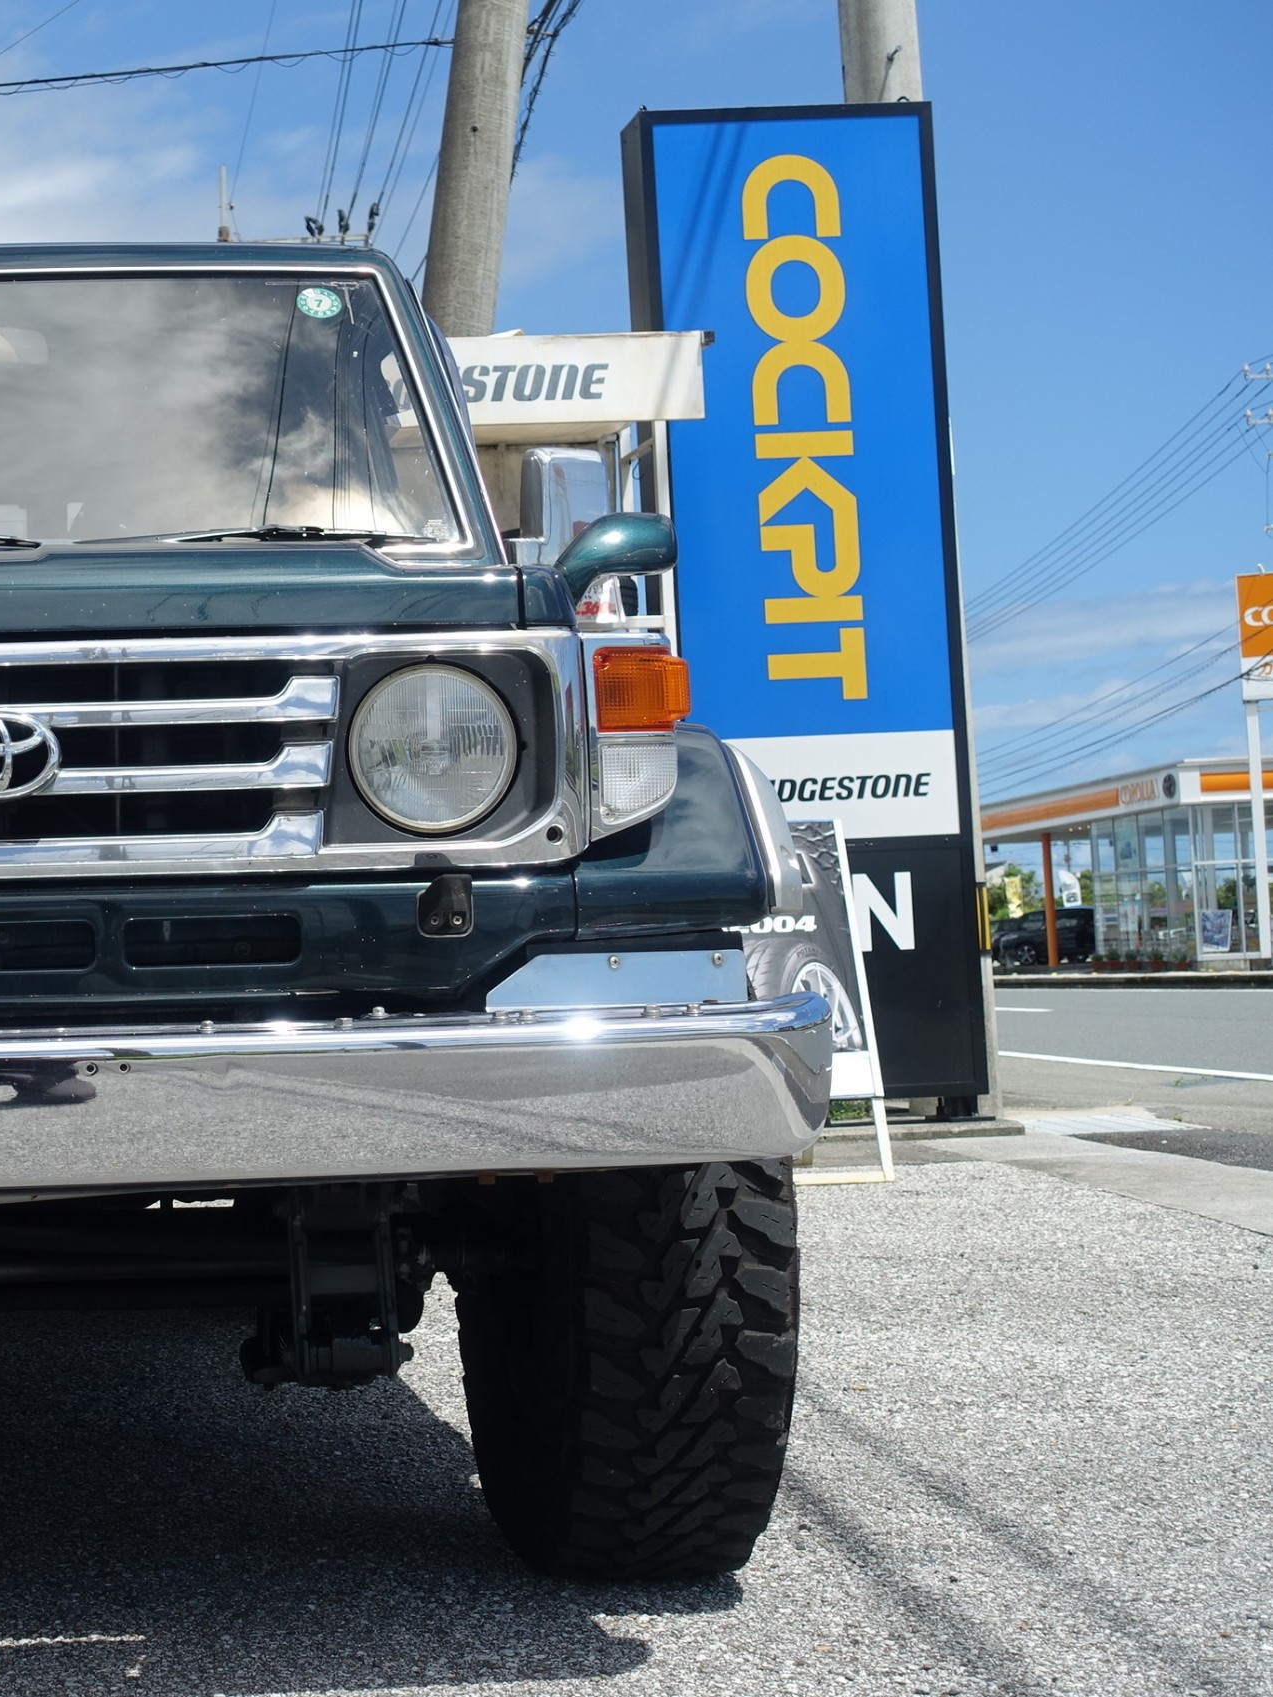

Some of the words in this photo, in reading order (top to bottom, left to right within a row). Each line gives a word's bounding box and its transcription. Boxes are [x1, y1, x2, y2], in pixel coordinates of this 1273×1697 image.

[458, 363, 609, 403] STONE
[740, 153, 868, 701] COCKPIT
[769, 773, 932, 803] DGESTONE
[721, 914, 818, 934] 004
